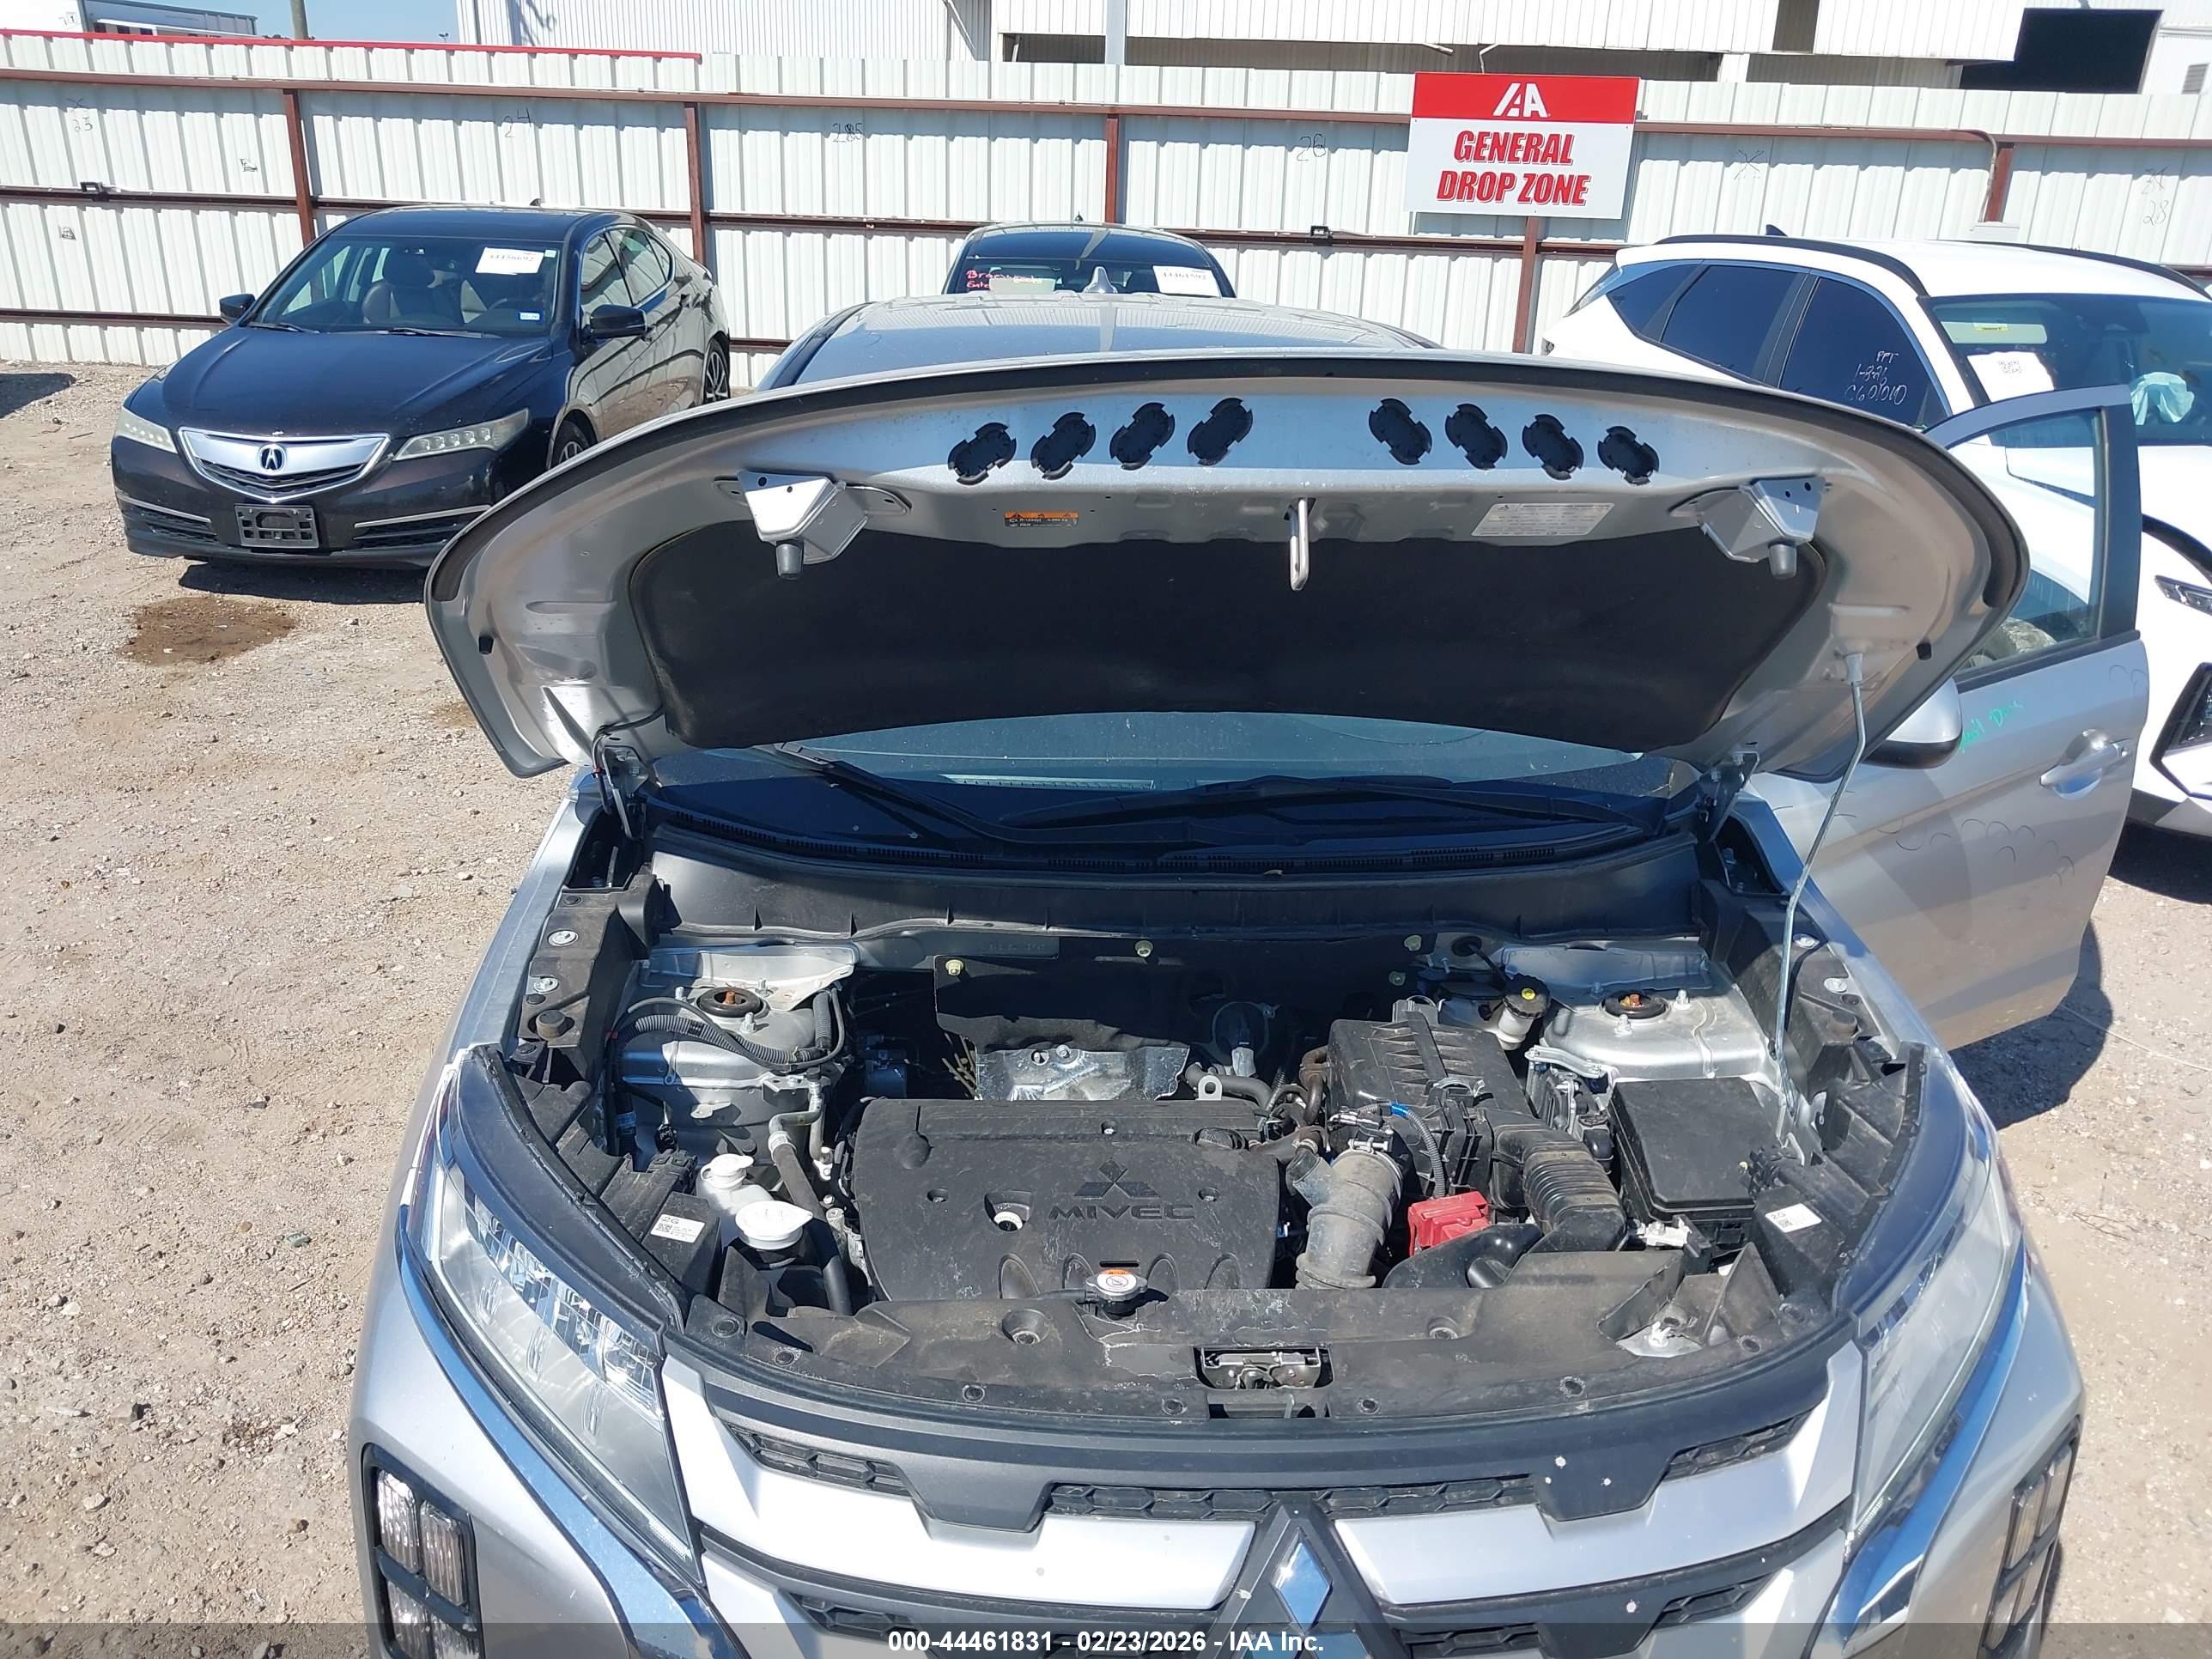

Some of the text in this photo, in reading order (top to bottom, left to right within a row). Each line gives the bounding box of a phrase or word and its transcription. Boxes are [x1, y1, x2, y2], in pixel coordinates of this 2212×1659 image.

[503, 107, 532, 138] 24
[1454, 130, 1575, 166] GENERAL
[1436, 170, 1591, 206] DROP ZONE
[1048, 1206, 1195, 1220] MIVEC
